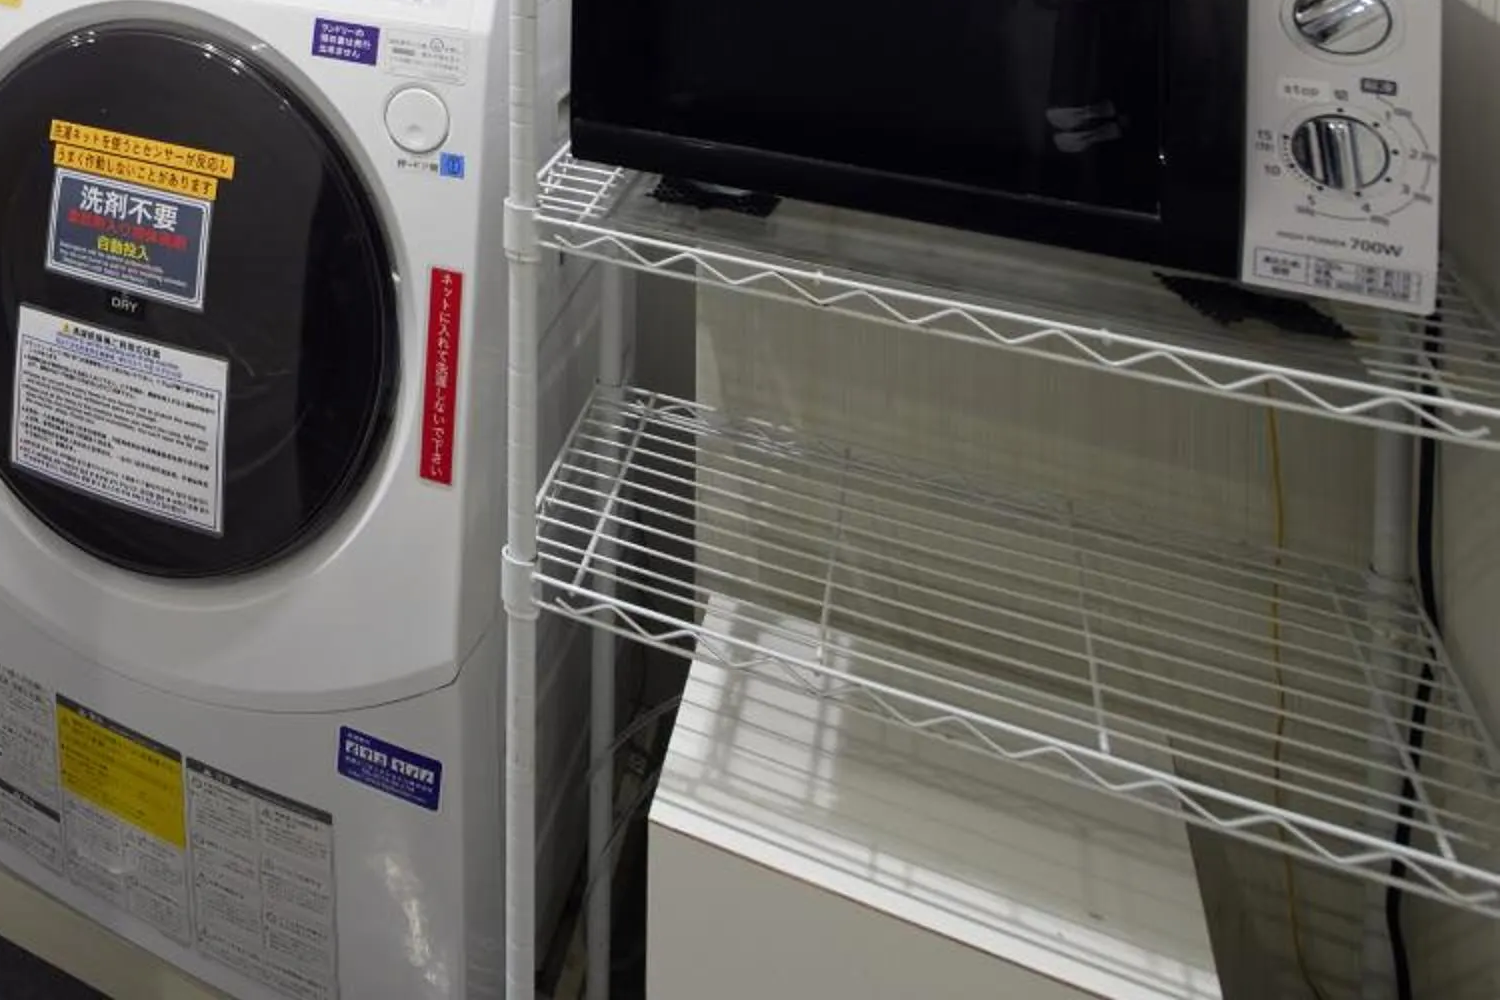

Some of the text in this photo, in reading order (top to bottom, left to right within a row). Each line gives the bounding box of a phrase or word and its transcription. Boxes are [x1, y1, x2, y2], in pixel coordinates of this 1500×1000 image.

[1284, 84, 1319, 97] stop
[79, 185, 179, 232] 洗剤不要
[1350, 237, 1404, 258] 700W
[110, 296, 138, 313] DRY
